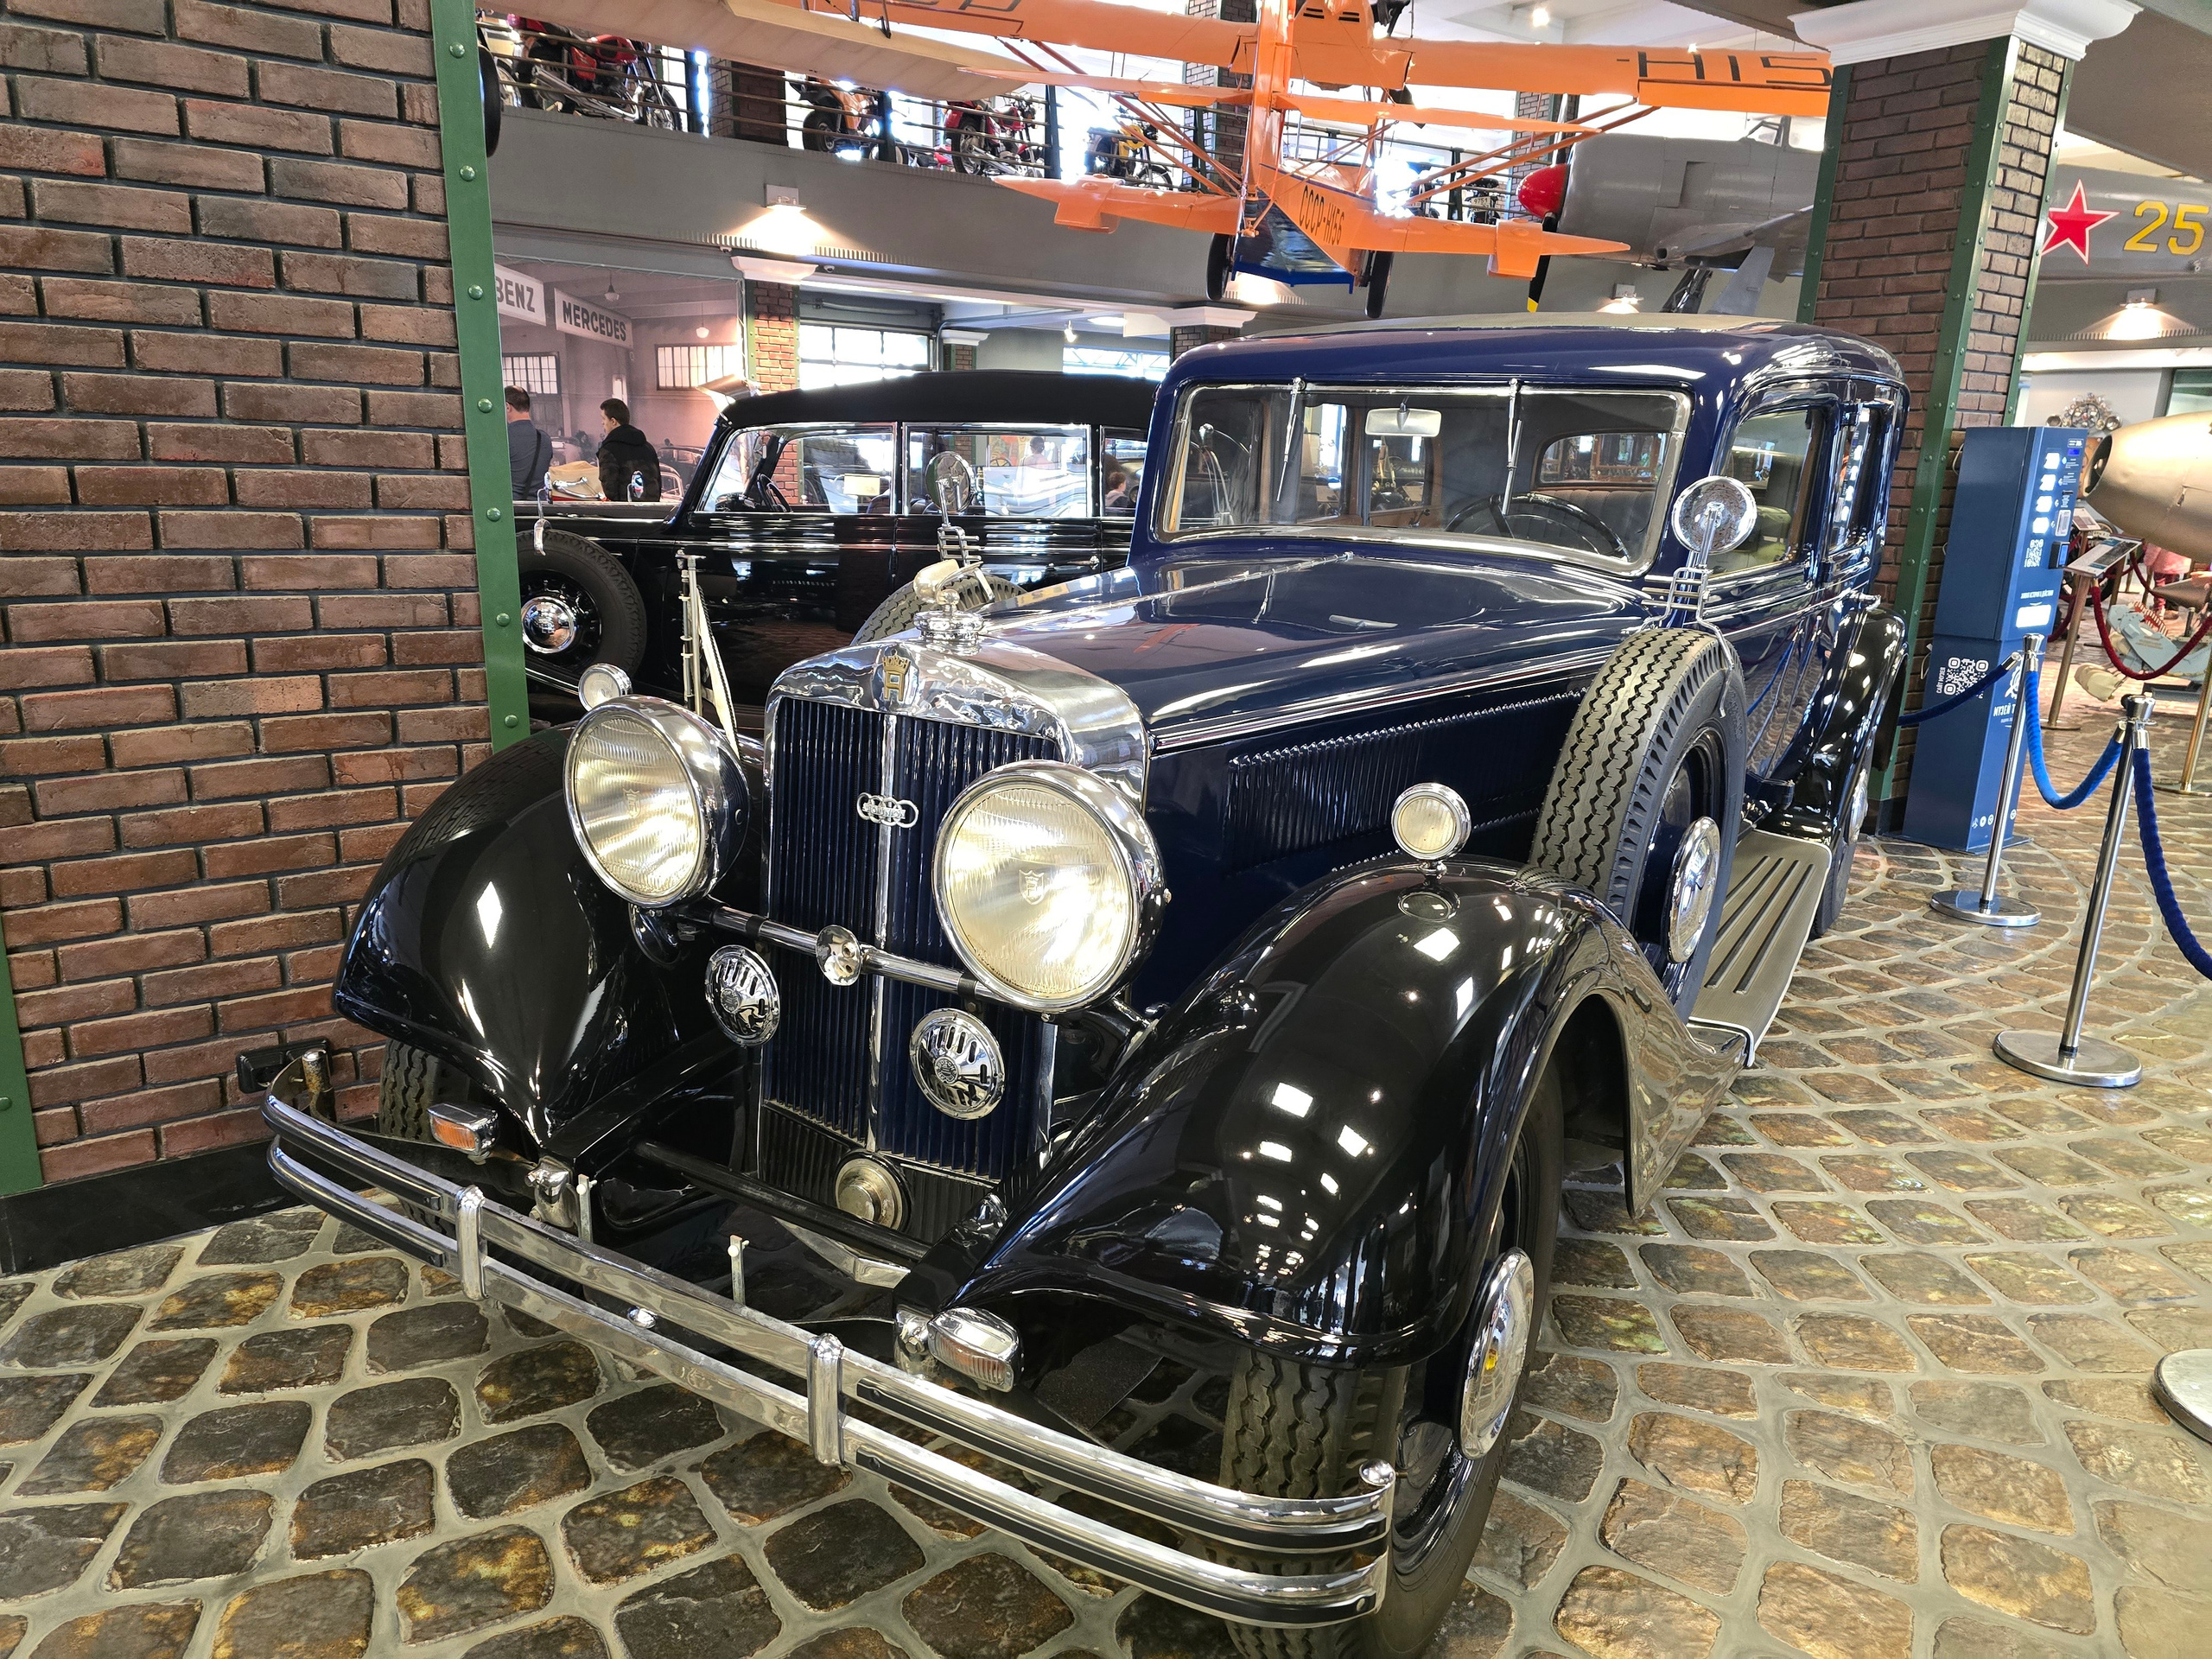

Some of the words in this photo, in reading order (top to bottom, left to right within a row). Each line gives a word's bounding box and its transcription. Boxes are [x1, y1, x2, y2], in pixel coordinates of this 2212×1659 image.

[2123, 200, 2210, 256] 25
[563, 300, 626, 342] MERCEDES
[882, 654, 912, 669] HORCH
[1993, 702, 2012, 717] МУЗЕЙ
